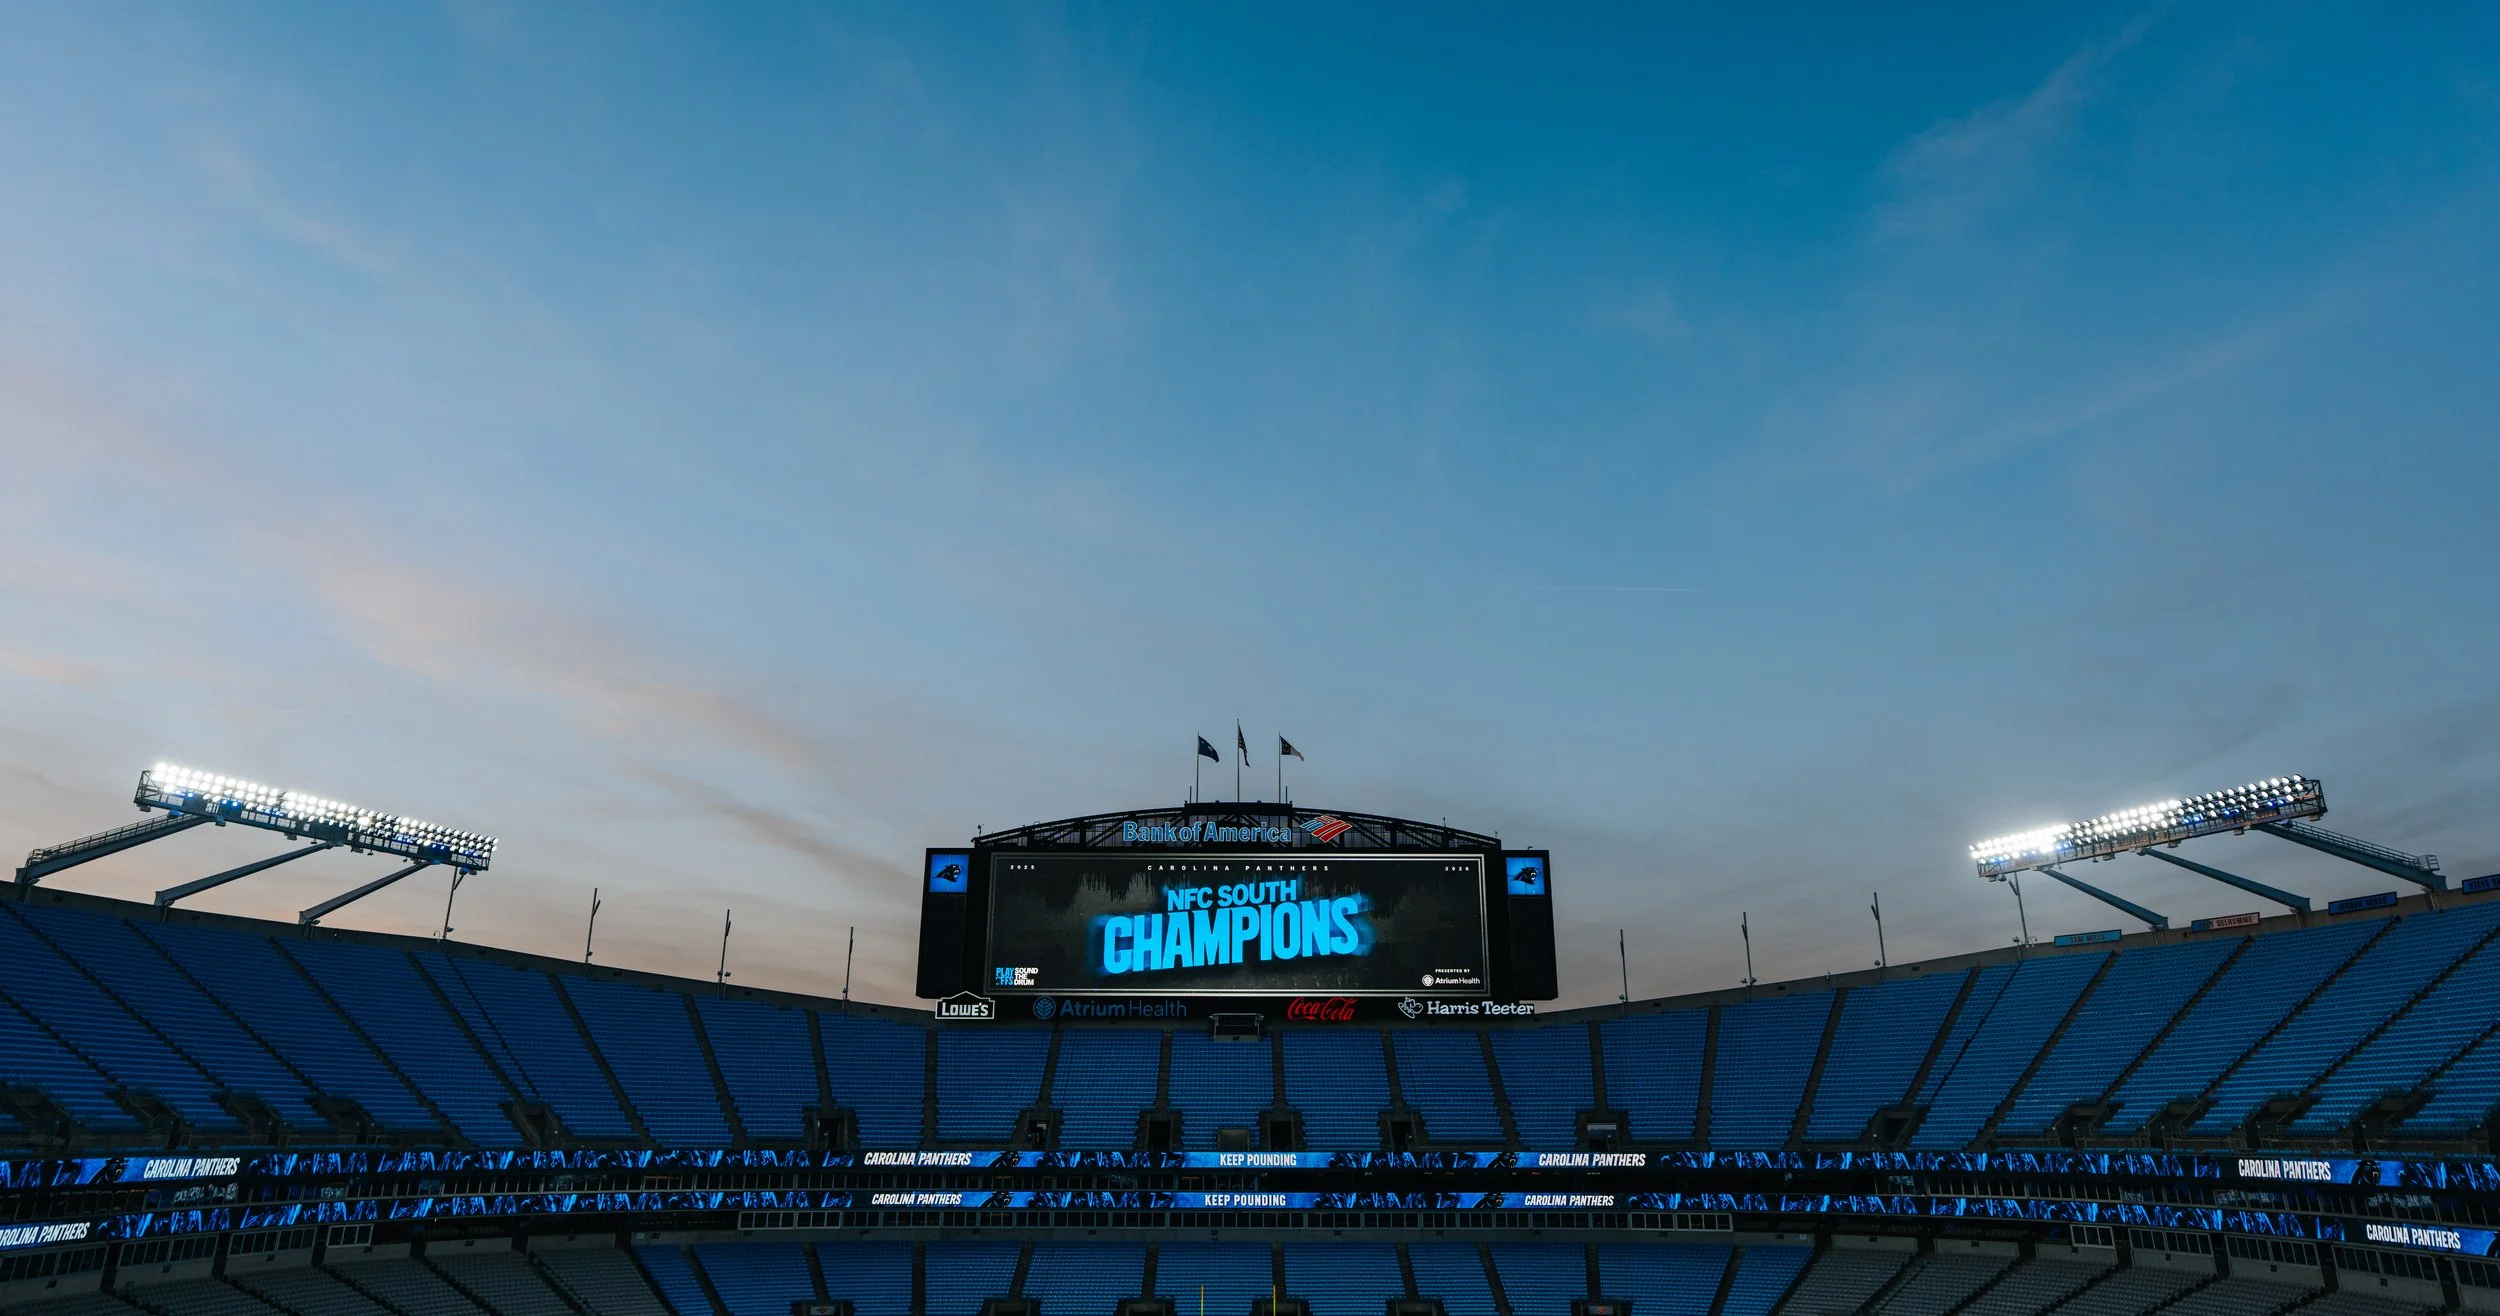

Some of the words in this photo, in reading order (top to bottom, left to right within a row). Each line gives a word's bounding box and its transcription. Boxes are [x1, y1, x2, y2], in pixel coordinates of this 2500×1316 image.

[1123, 821, 1177, 842] Bank
[1179, 822, 1201, 842] of
[1203, 821, 1292, 842] America
[1168, 886, 1213, 911] NFC
[1218, 879, 1297, 907] SOUTH
[1103, 896, 1359, 974] CHAMPIONS
[996, 967, 1014, 977] PLAY
[1060, 1000, 1125, 1017] Atrium
[1129, 1000, 1187, 1017] Health
[1427, 1001, 1479, 1015] Harris
[1482, 1001, 1534, 1015] Teeter
[863, 1152, 917, 1166] CAROLINA
[918, 1152, 972, 1166] PANTHERS
[1220, 1153, 1245, 1166] KEEP
[1246, 1153, 1297, 1166] POUNDING
[1538, 1153, 1590, 1167] CAROLINA
[1592, 1153, 1646, 1167] PANTHERS
[144, 1159, 193, 1179] CAROLINA
[191, 1157, 241, 1177] PANTHERS
[2238, 1158, 2282, 1179] CAROLINA
[2283, 1160, 2332, 1181] PANTHERS
[871, 1193, 916, 1205] CAROLINA
[916, 1193, 963, 1205] PANTHERS
[1205, 1194, 1231, 1206] KEEP
[1233, 1194, 1286, 1206] POUNDING
[1524, 1194, 1567, 1206] CAROLINA
[1568, 1194, 1615, 1207] PANTHERS
[37, 1221, 91, 1244] PANTHERS
[2366, 1223, 2411, 1244] CAROLINA
[2410, 1227, 2462, 1250] PANTHERS
